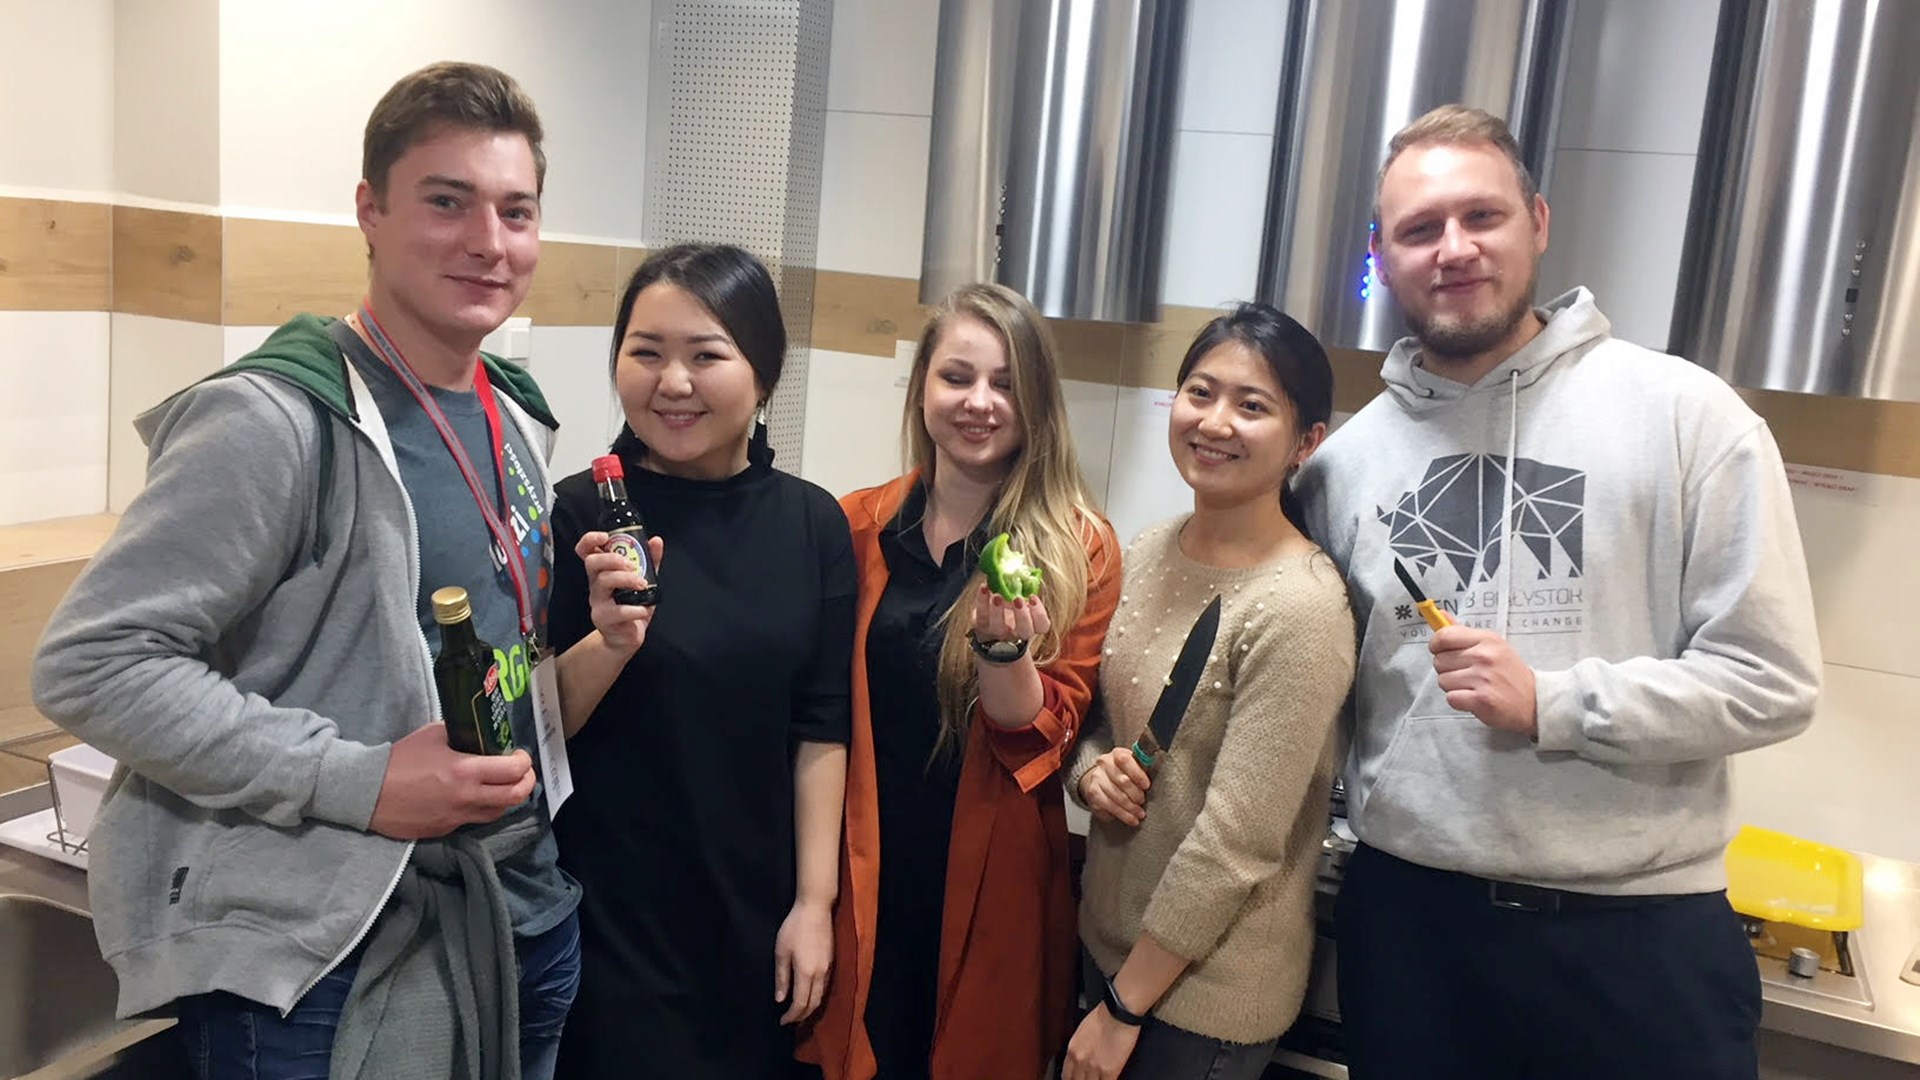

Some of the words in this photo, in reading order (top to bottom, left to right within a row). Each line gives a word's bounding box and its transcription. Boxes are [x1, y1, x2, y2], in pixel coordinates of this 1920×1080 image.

[1401, 629, 1428, 638] YOU
[1464, 619, 1493, 629] AKE
[1522, 616, 1583, 628] CHANGE
